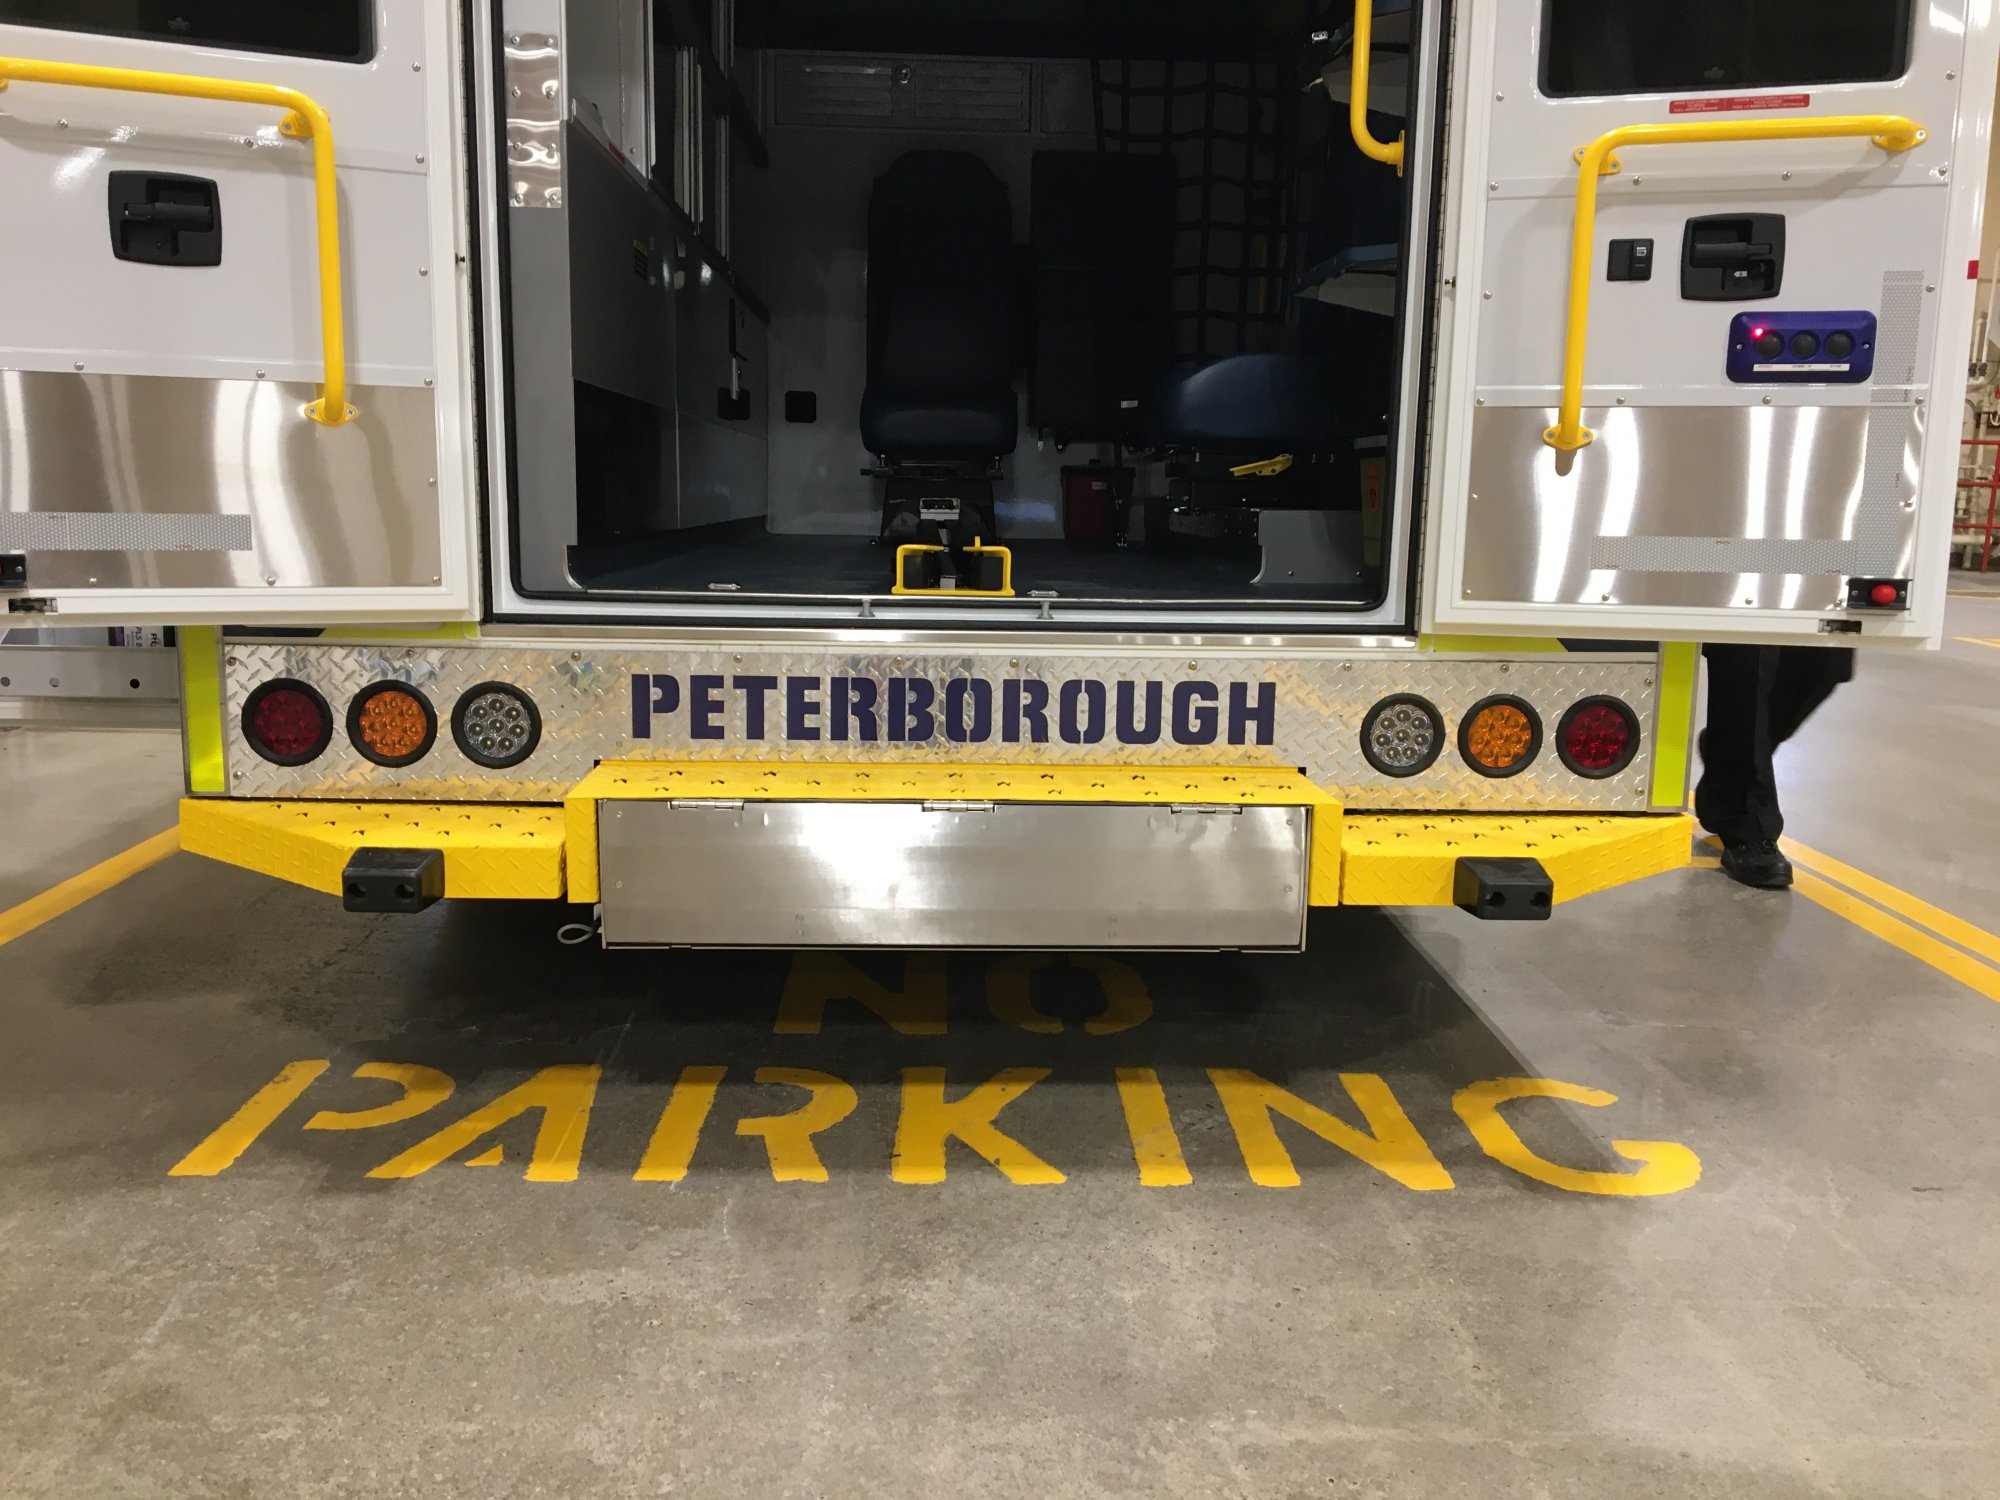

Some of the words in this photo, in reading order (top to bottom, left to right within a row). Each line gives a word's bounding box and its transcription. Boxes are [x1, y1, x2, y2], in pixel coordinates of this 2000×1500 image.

[631, 673, 1275, 746] PETERBOROUGH
[772, 951, 1154, 1036] NO
[167, 1059, 1704, 1199] PARKING
